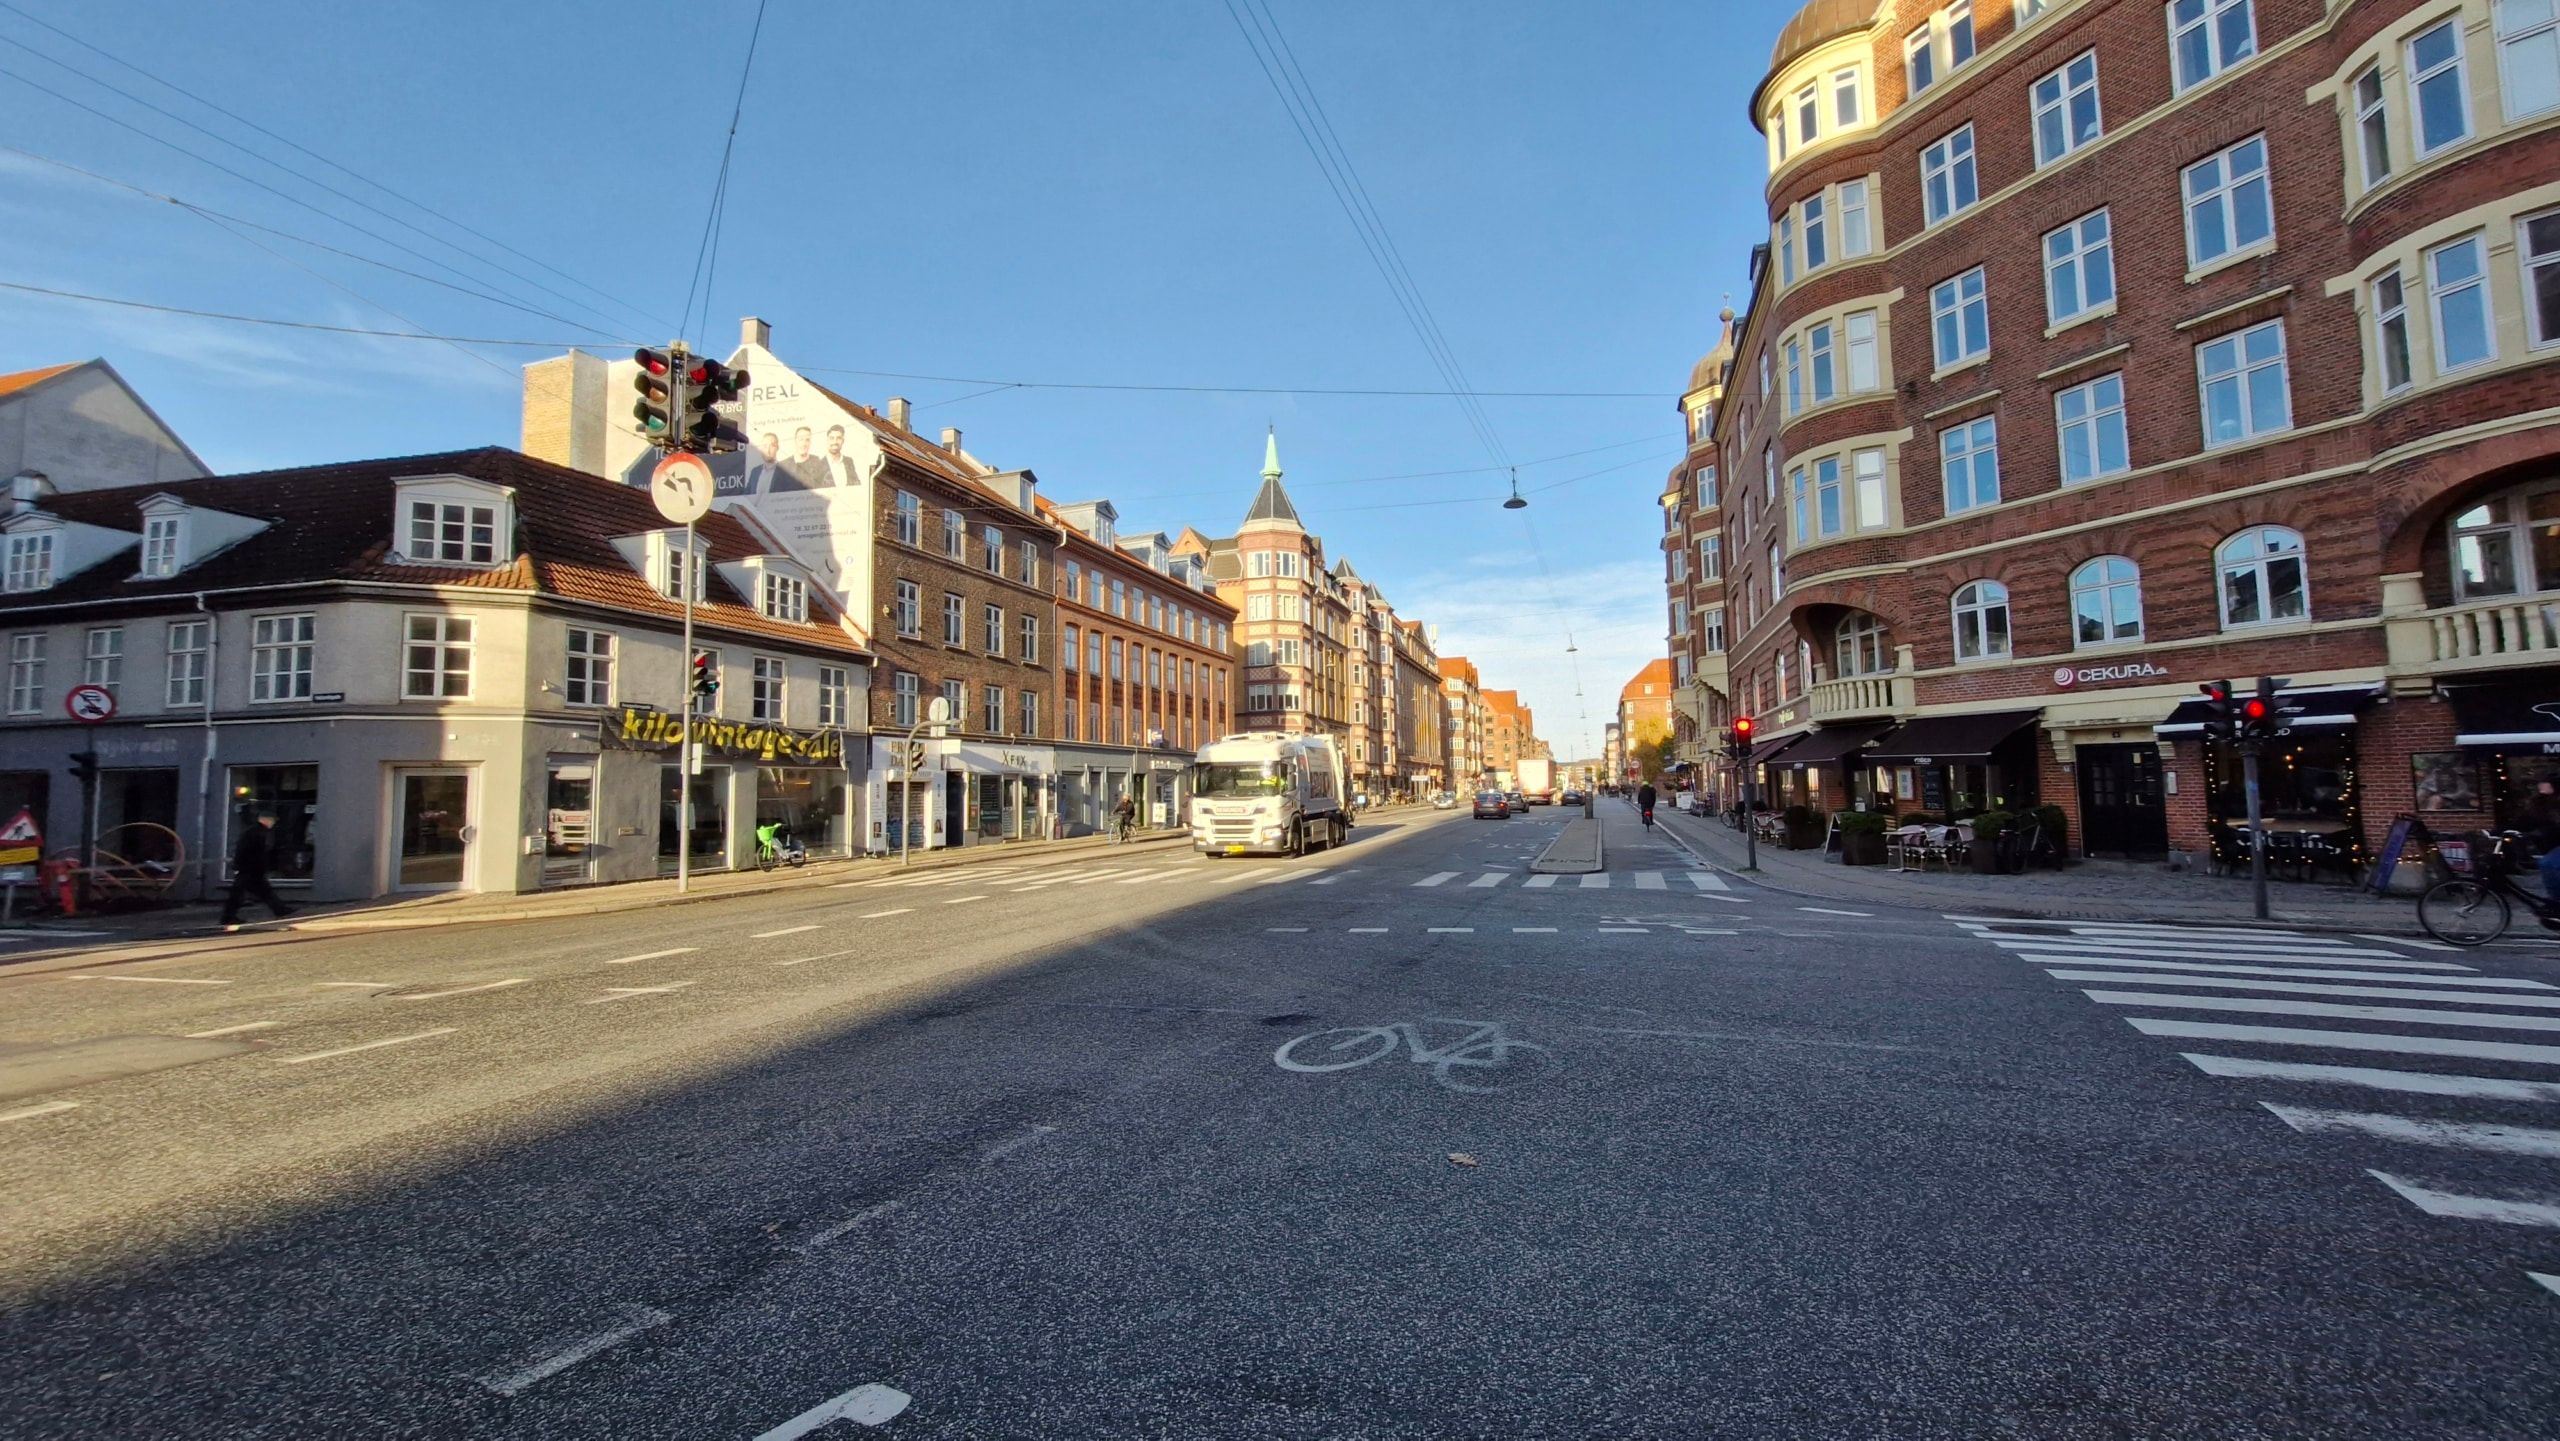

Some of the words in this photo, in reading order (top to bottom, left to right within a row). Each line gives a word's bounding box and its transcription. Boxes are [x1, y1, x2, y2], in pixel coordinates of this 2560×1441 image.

[752, 384, 800, 401] REAL
[622, 709, 684, 743] kilo
[690, 718, 793, 760] vintage
[797, 732, 840, 760] sale
